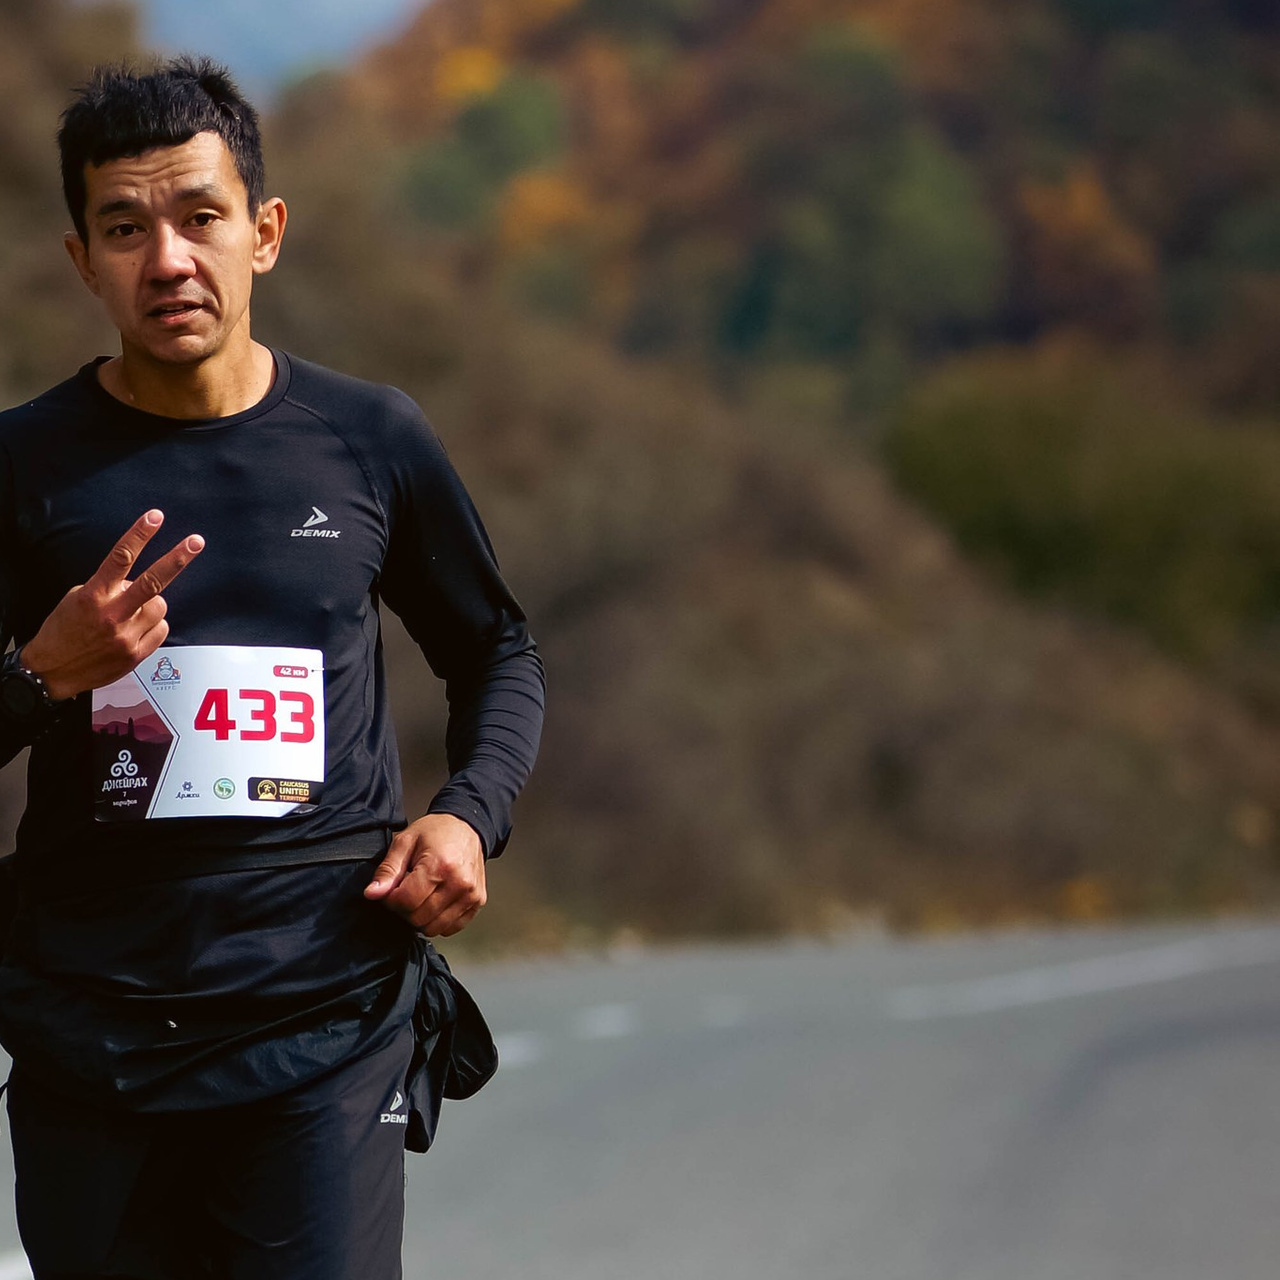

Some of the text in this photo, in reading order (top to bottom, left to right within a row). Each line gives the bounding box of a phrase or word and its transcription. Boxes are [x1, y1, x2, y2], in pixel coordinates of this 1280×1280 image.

[290, 529, 341, 538] DEMIX
[280, 667, 291, 676] 42
[194, 688, 315, 743] 433
[102, 777, 148, 792] ДЖЕЙРАХ
[280, 788, 309, 796] UNITED
